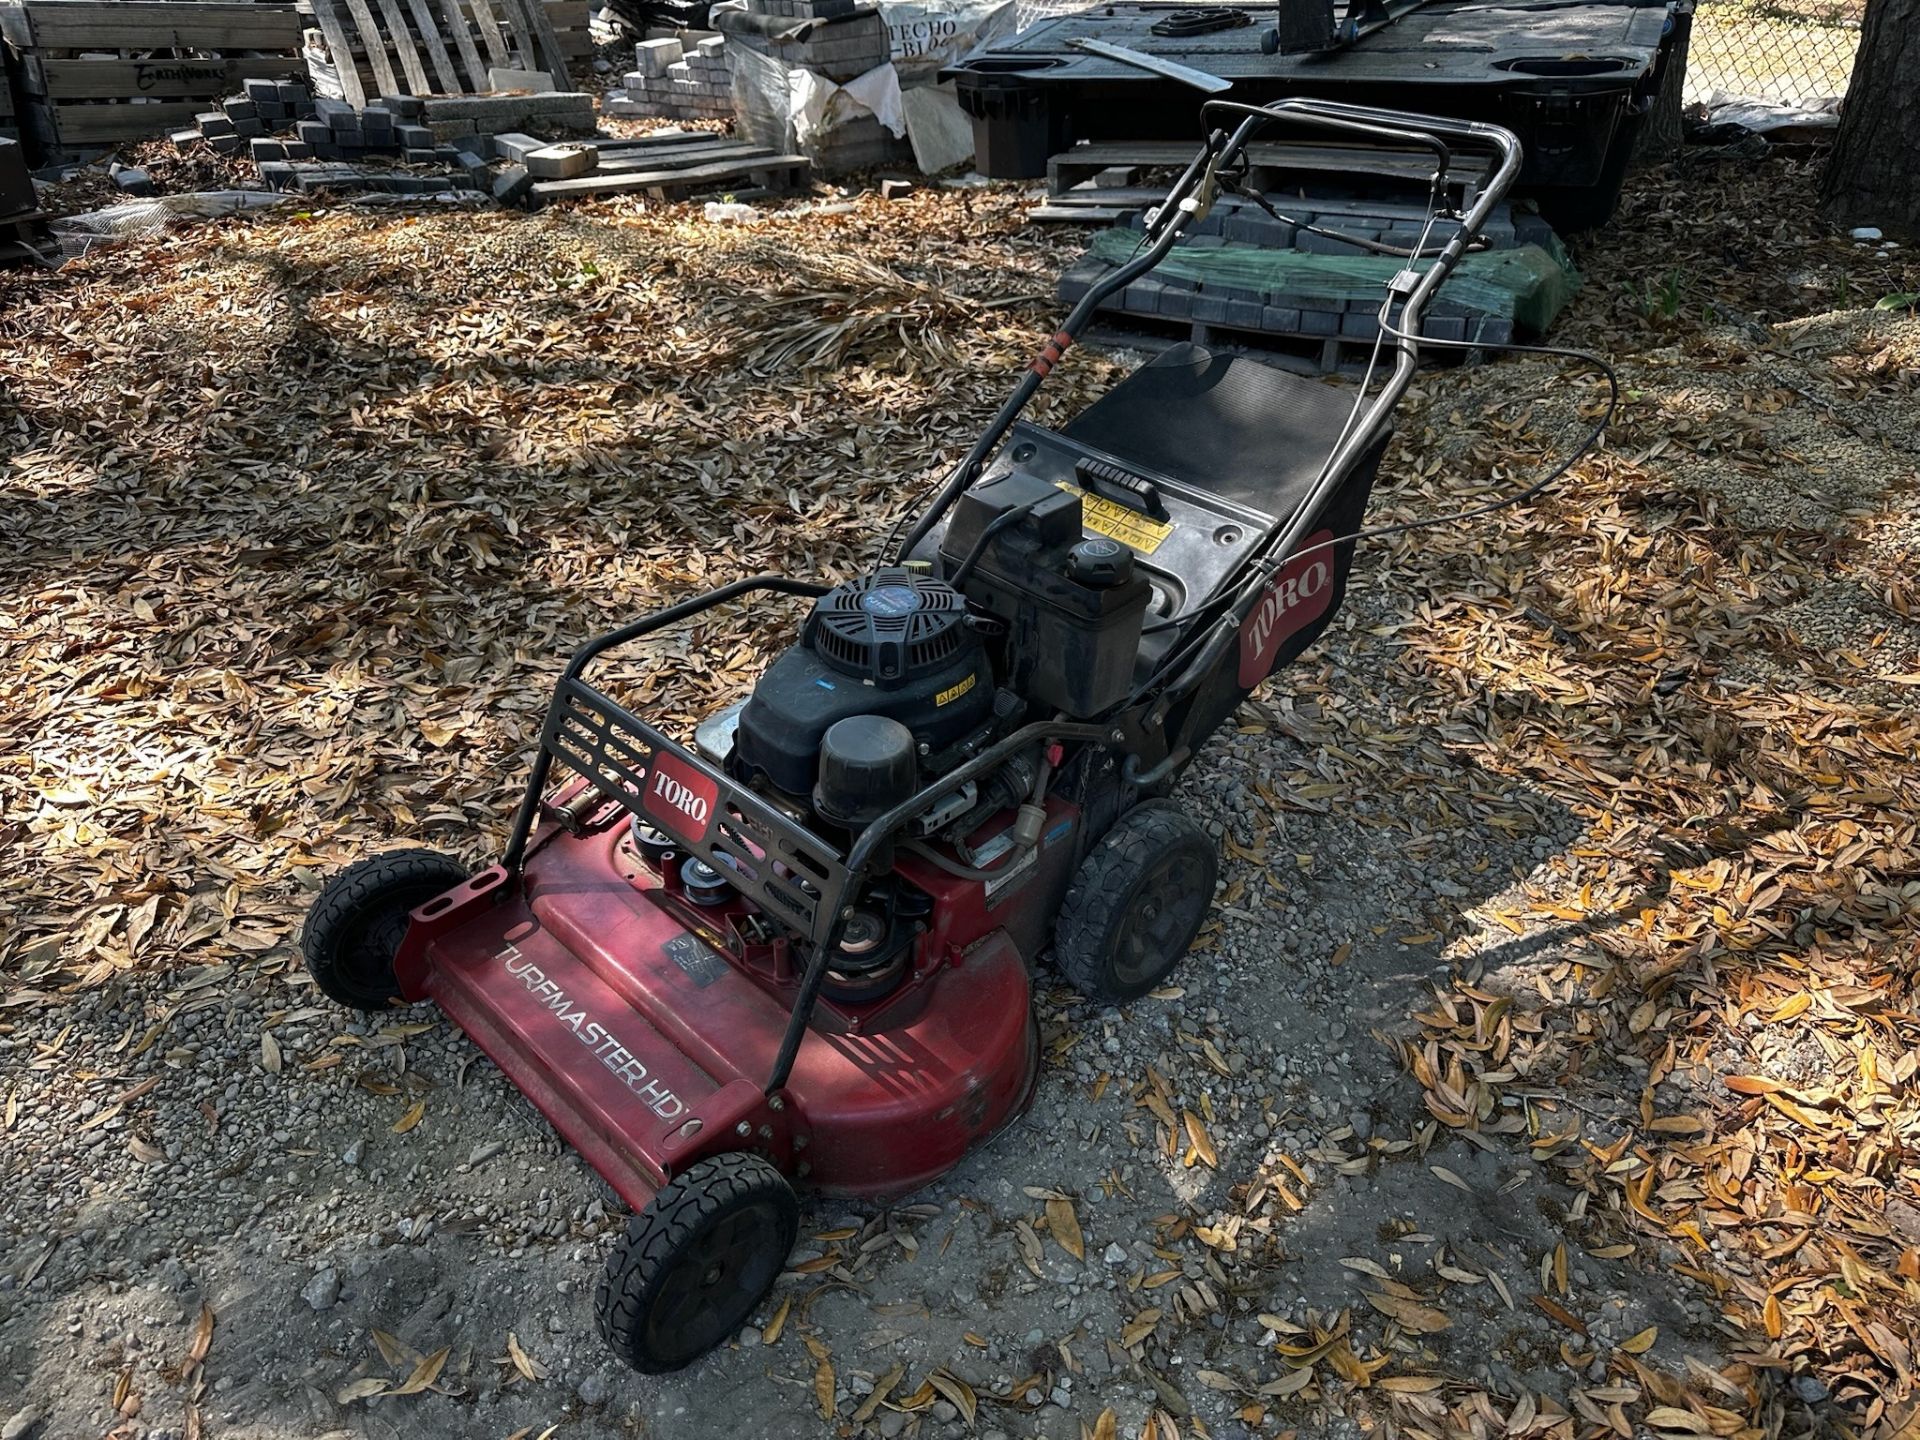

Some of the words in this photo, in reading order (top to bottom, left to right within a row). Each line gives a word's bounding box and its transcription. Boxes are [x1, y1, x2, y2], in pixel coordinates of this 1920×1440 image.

[889, 20, 956, 41] TECHO
[1248, 561, 1327, 661] TORO
[653, 770, 708, 822] TORO
[494, 943, 648, 1089] TURFMASTER
